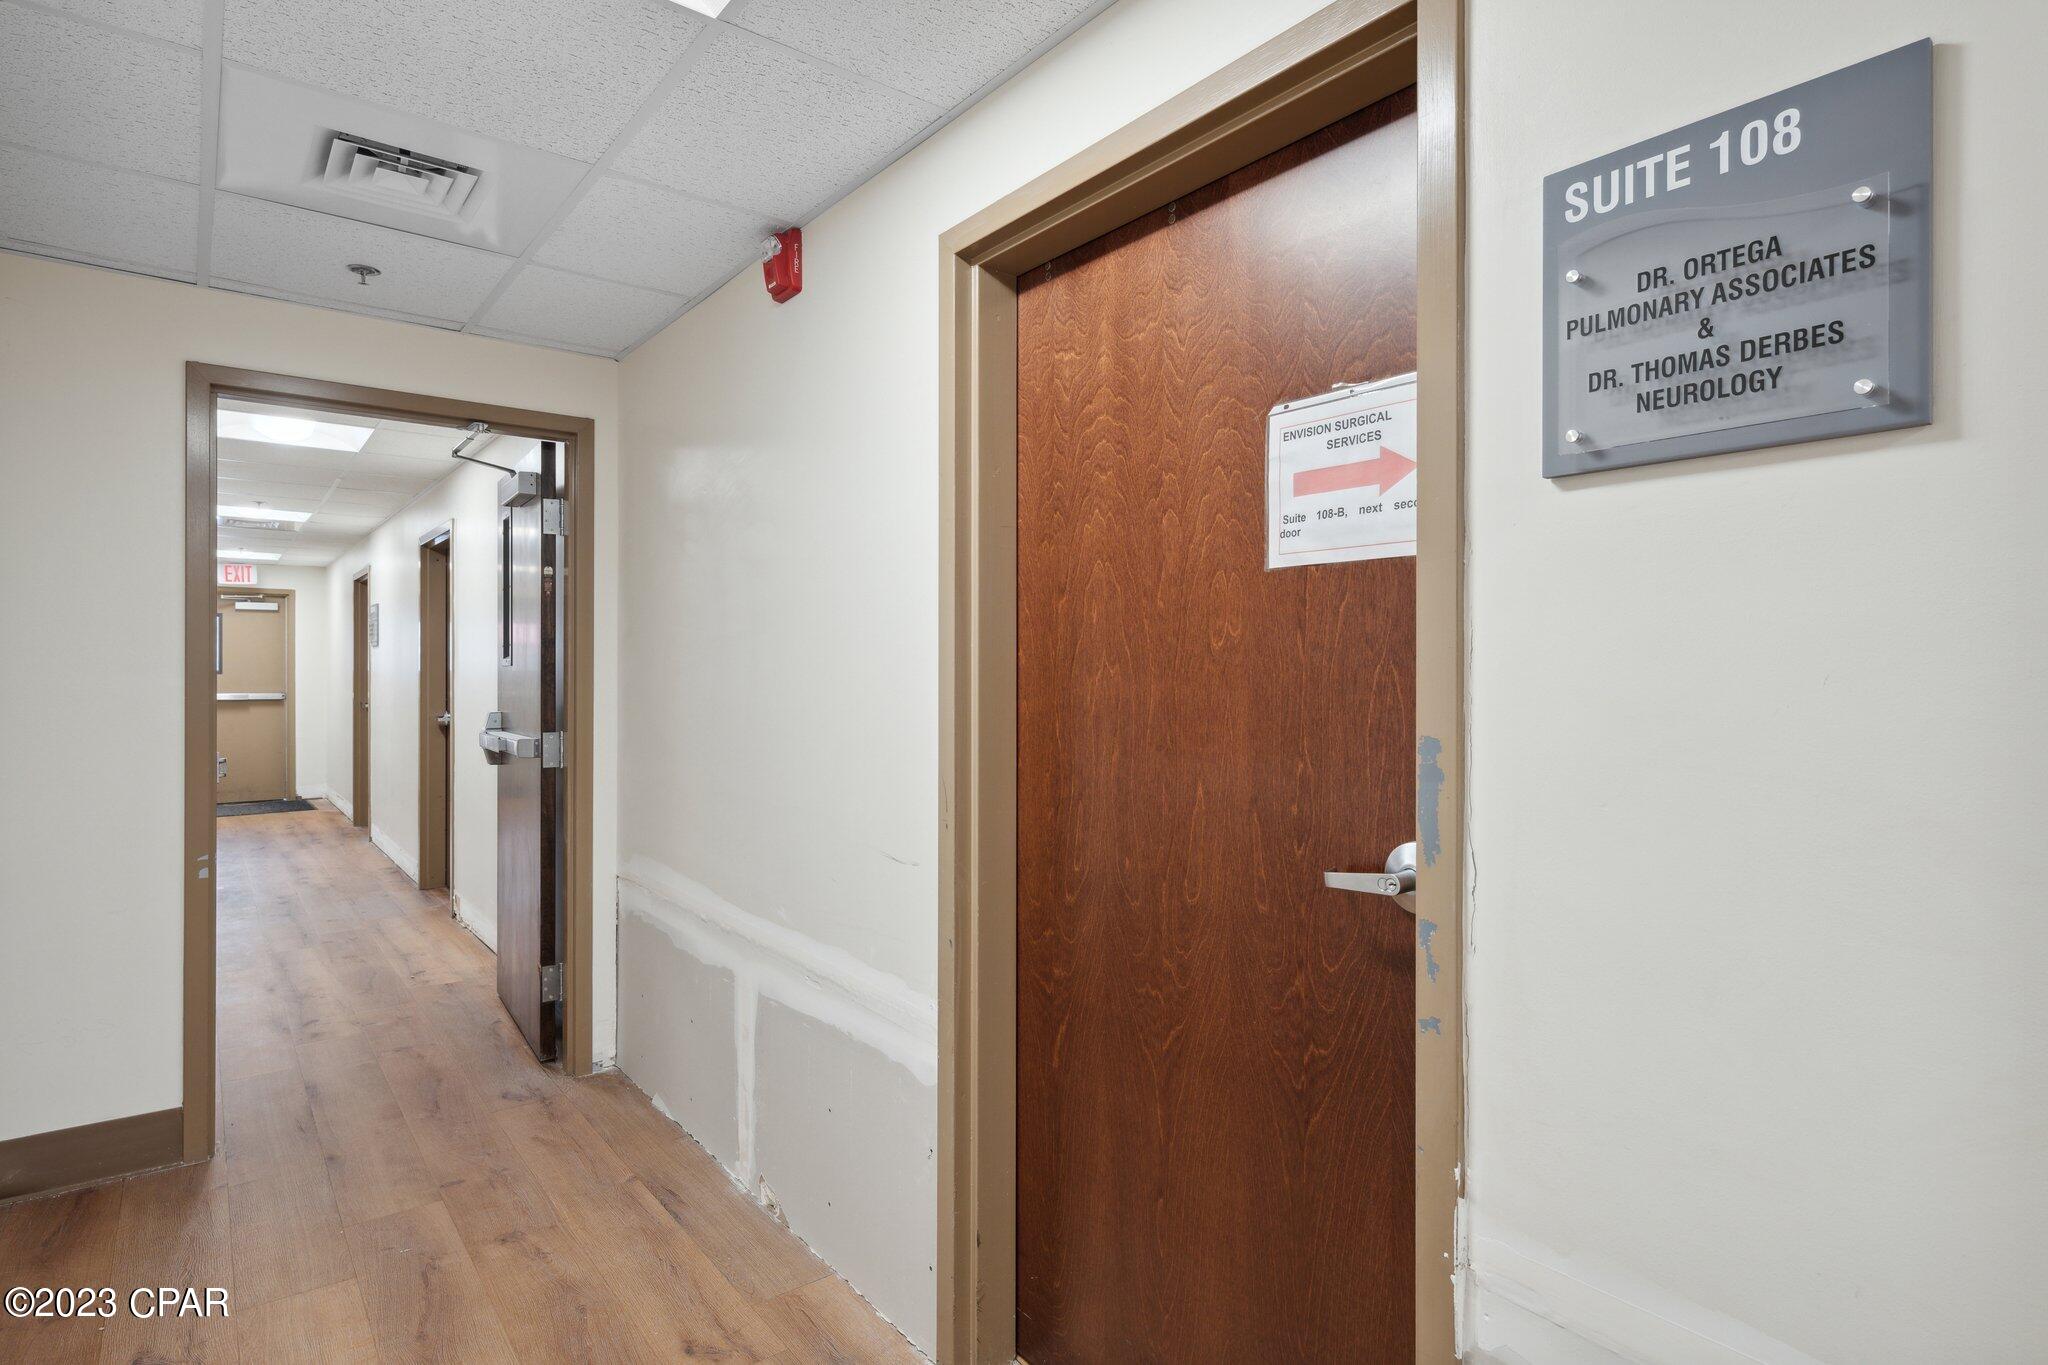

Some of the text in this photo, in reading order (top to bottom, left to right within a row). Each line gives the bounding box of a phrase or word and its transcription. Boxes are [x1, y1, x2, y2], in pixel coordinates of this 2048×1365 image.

[1564, 107, 1802, 224] SUITE 108
[1637, 235, 1783, 293] DR. ORTEGA
[1566, 244, 1877, 340] PULMONARY ASSOCIATES
[1697, 317, 1715, 340] &
[1588, 319, 1845, 393] DR. THOMAS DERBES
[1636, 365, 1784, 414] NEUROLOGY
[1283, 410, 1393, 442] ENVISION SURGICAL
[1326, 429, 1383, 450] SERVICES
[1282, 512, 1307, 525] Suite
[1316, 507, 1348, 520] 108-B,
[1359, 502, 1383, 515] next
[1280, 527, 1302, 539] door
[224, 565, 252, 583] EXIT
